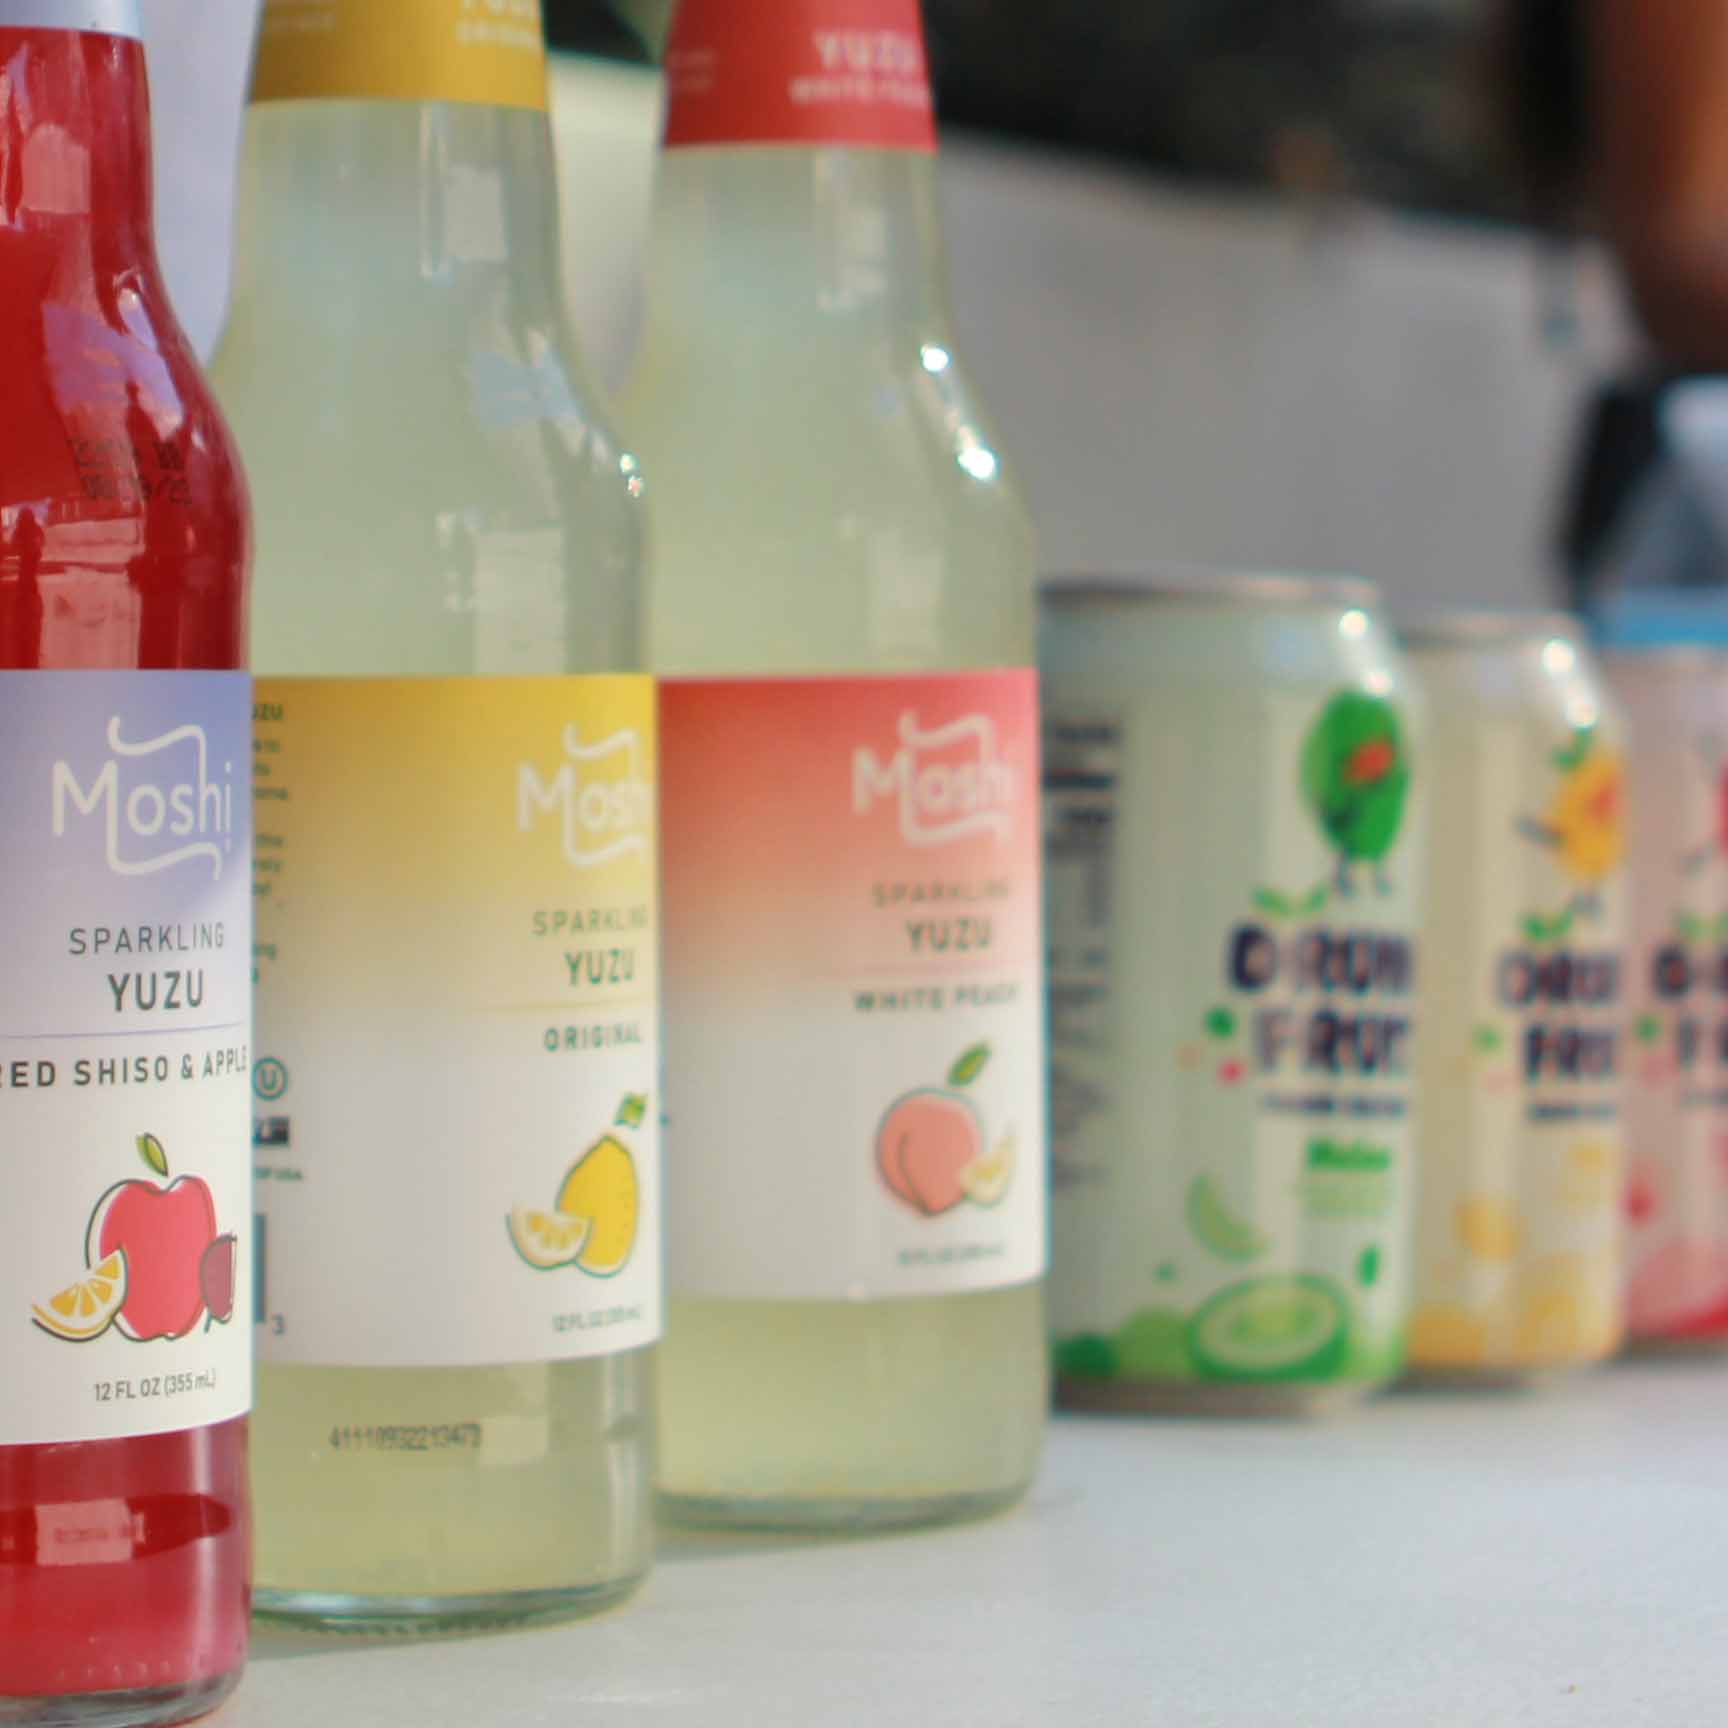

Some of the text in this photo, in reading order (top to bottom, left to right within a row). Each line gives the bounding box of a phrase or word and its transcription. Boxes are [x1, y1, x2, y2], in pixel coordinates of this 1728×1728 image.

[51, 715, 233, 882] Moshi
[69, 921, 225, 956] SPARKLING
[904, 917, 993, 953] YUZU
[565, 947, 637, 988] YUZU
[106, 968, 204, 1013] YUZU
[854, 987, 944, 1013] WHITE
[543, 1020, 643, 1053] ORIGINAL
[73, 1054, 170, 1088] SHISO
[180, 1053, 194, 1080] &
[94, 1381, 112, 1402] 12
[115, 1379, 137, 1400] FL
[140, 1376, 161, 1398] OZ
[164, 1372, 193, 1398] (355
